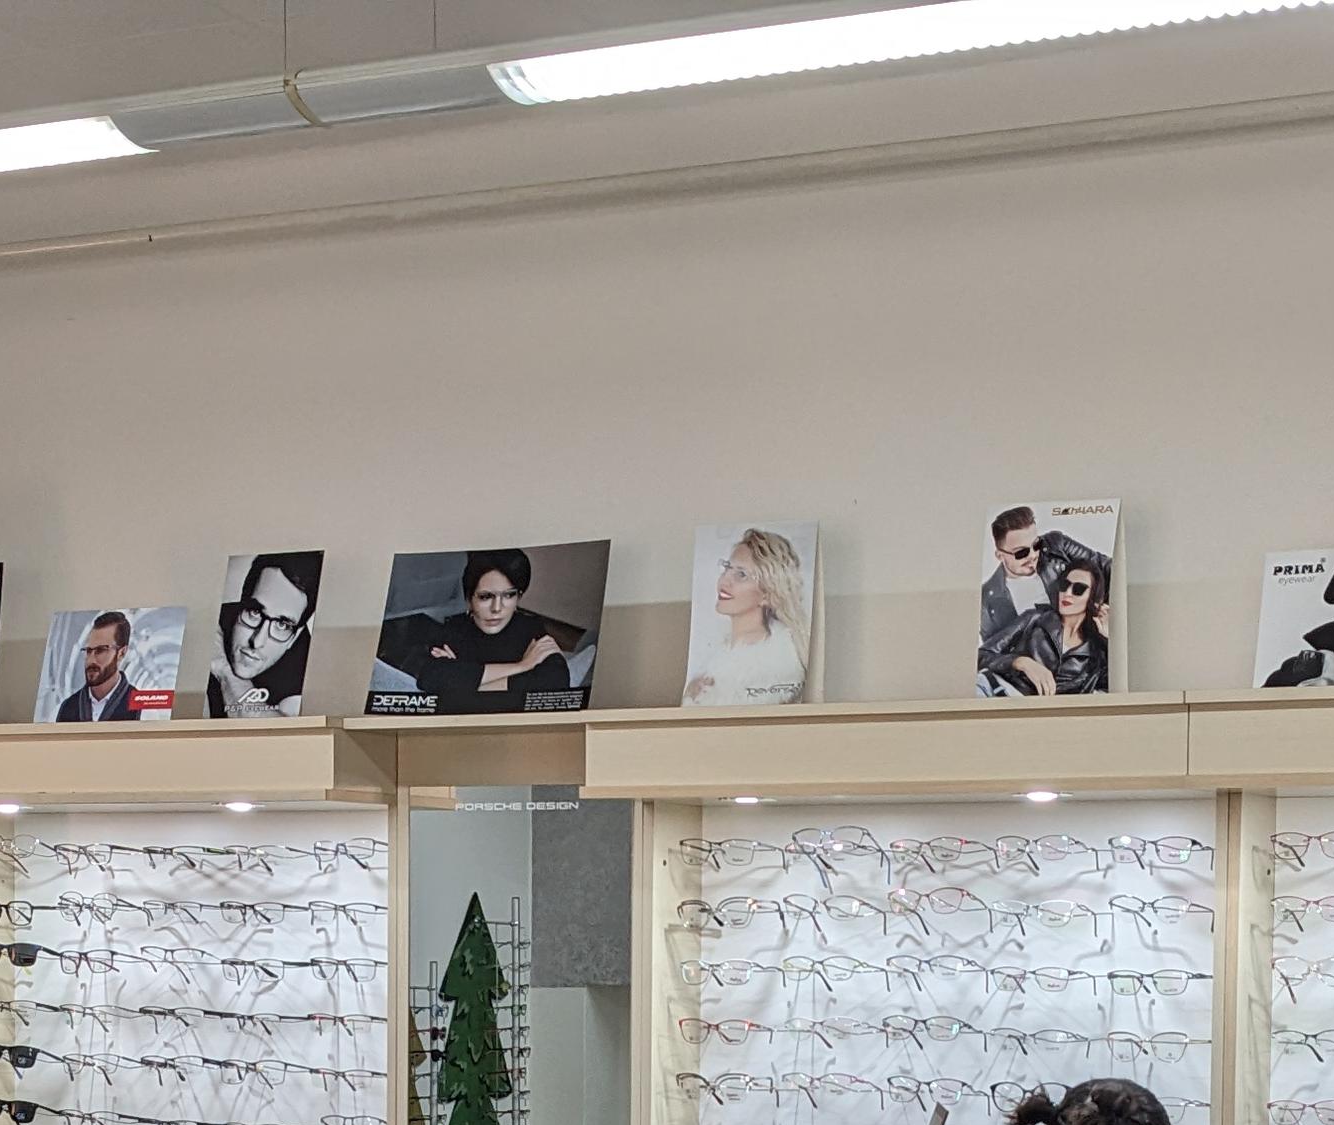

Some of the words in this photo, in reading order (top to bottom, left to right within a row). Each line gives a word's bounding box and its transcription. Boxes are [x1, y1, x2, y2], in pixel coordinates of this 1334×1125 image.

[1273, 563, 1325, 576] PRIMA
[372, 695, 438, 707] DEFRAME
[455, 802, 522, 811] PORSCHE
[526, 801, 579, 810] DESIGN
